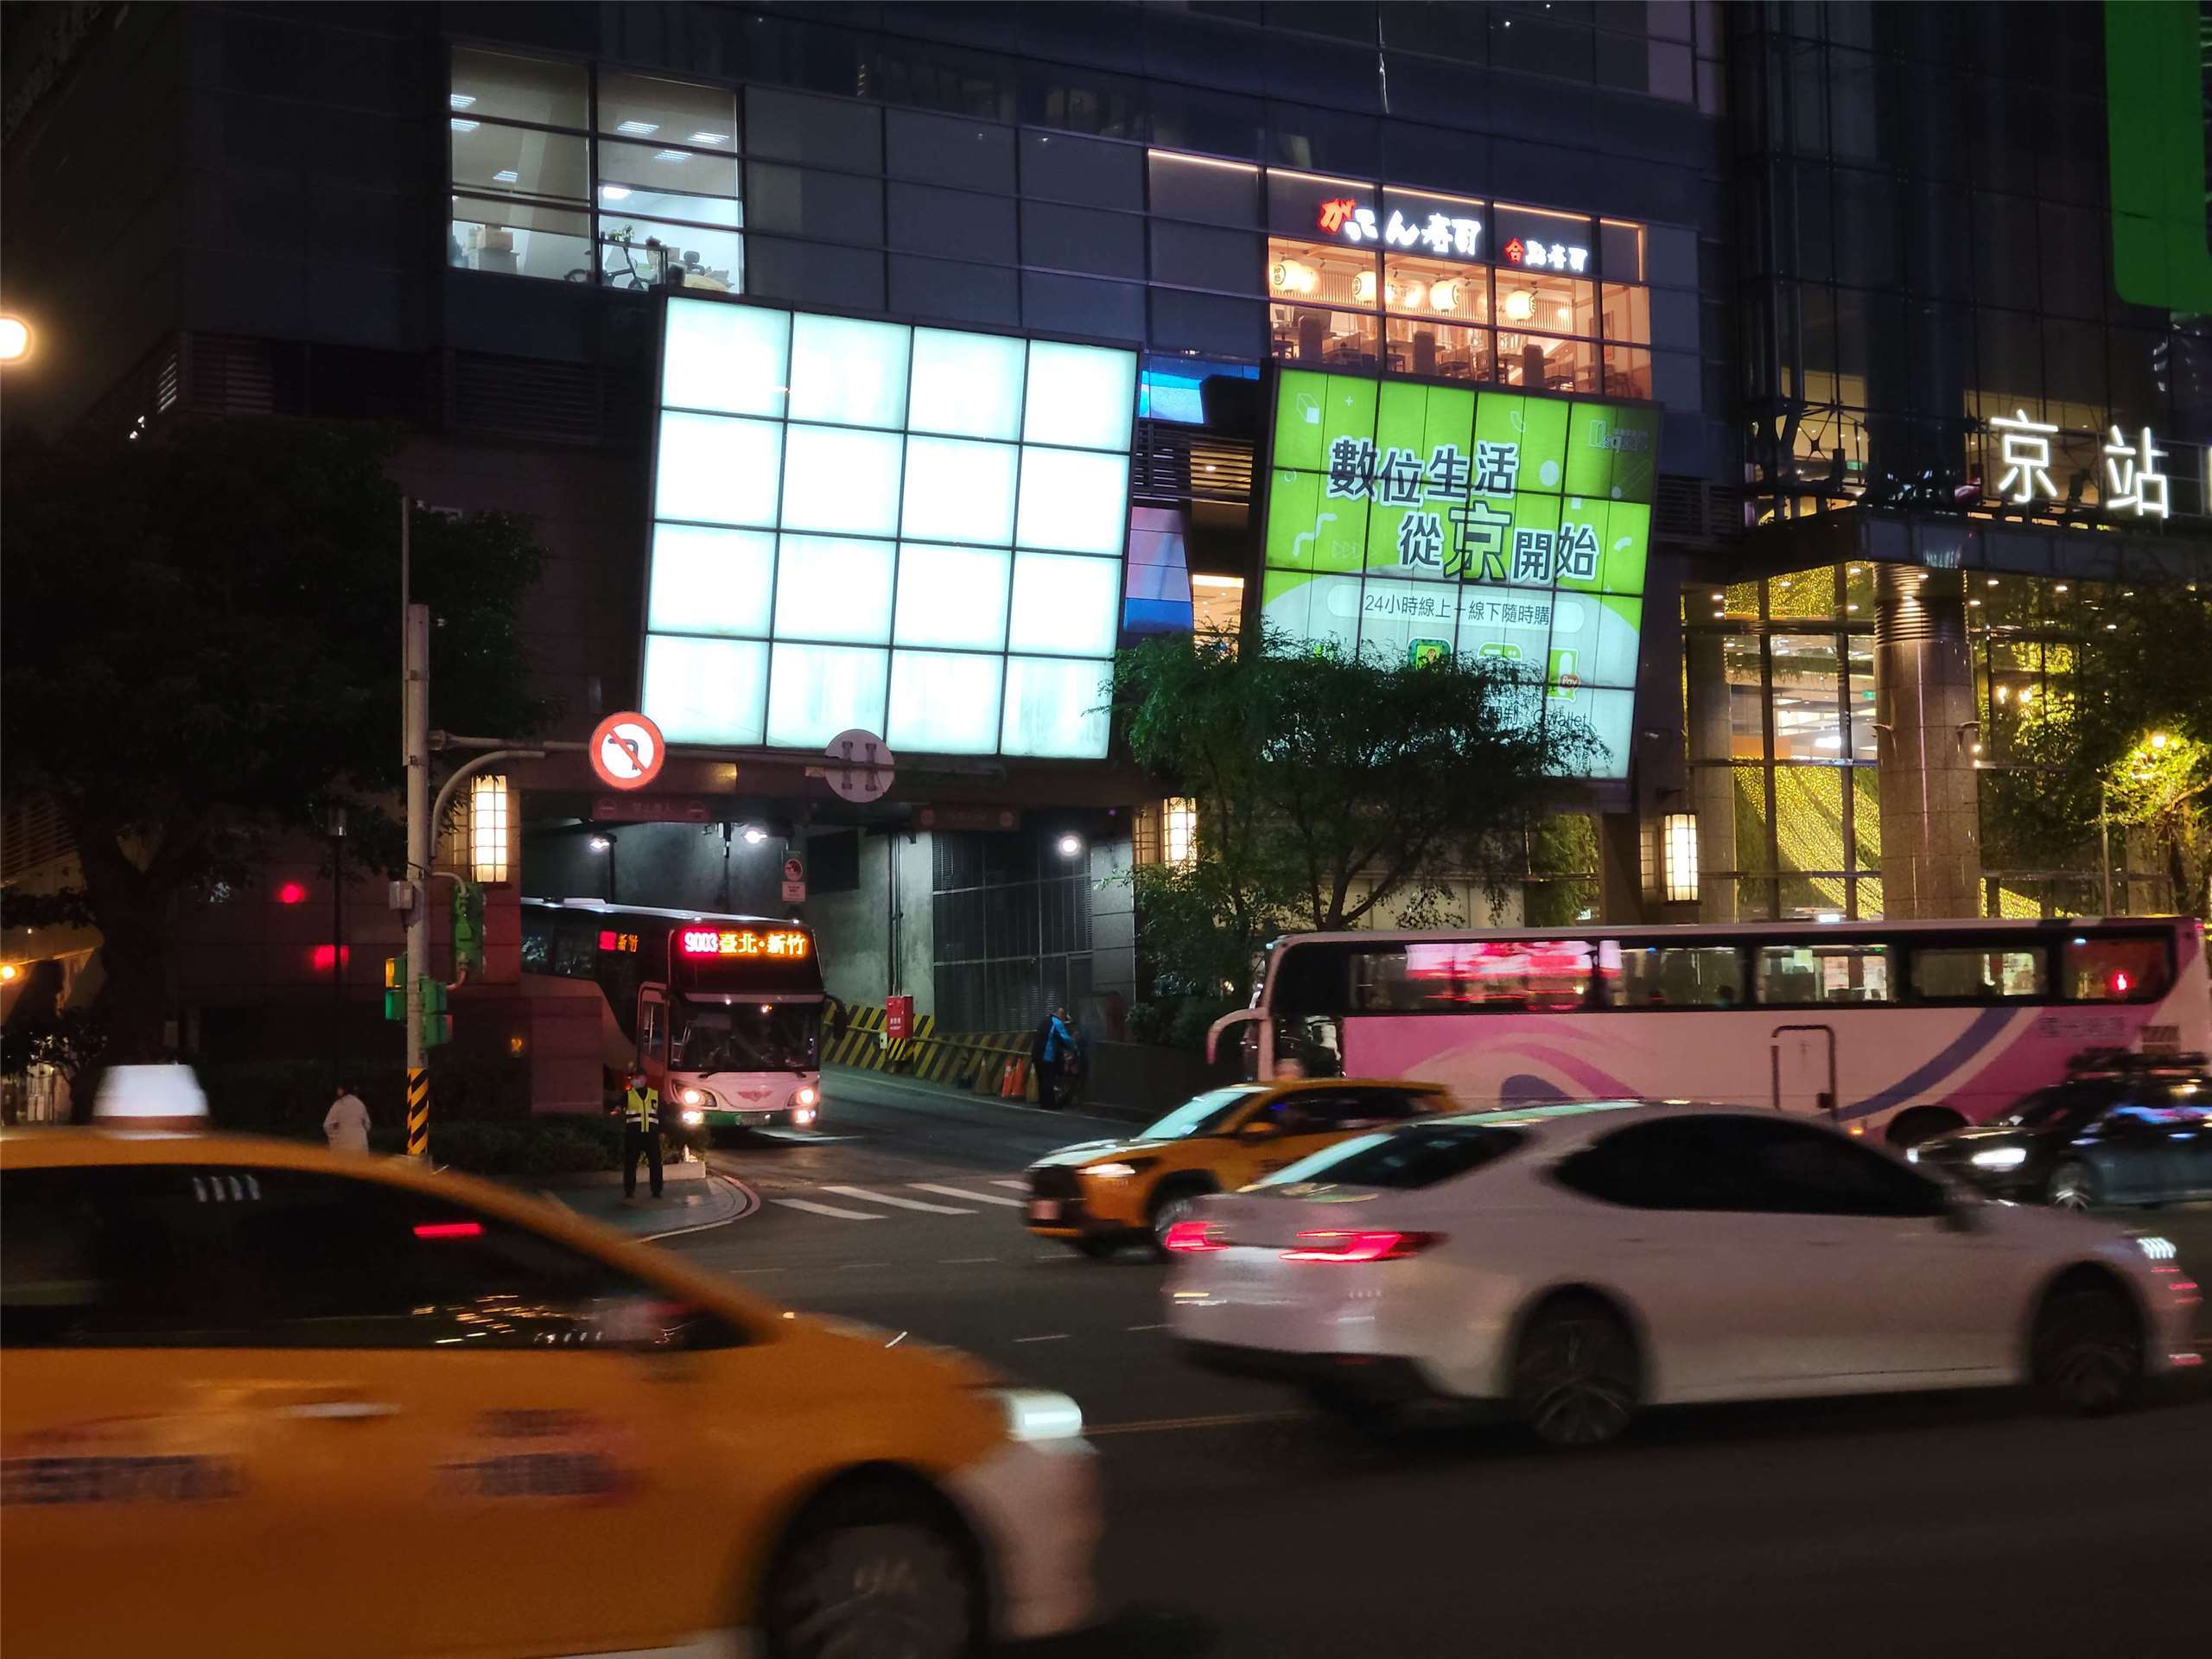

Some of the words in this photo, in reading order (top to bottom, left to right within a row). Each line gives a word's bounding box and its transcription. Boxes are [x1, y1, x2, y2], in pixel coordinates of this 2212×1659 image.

[1328, 437, 1517, 505] 數位生活
[1990, 409, 2212, 518] 京站
[1398, 499, 1598, 582] 從京開始
